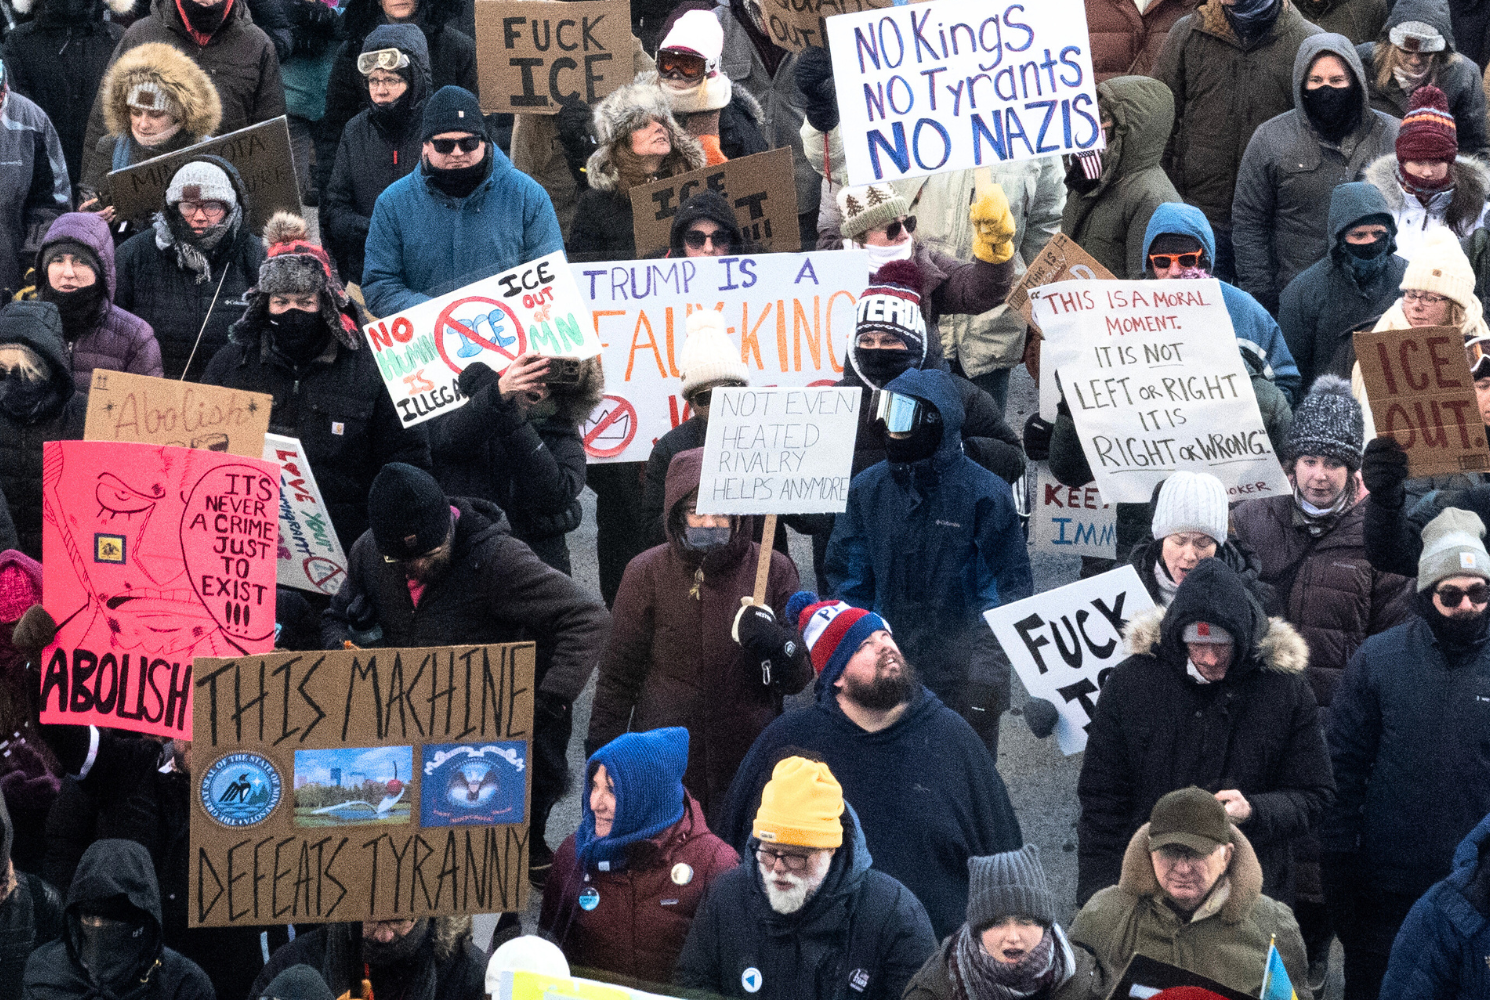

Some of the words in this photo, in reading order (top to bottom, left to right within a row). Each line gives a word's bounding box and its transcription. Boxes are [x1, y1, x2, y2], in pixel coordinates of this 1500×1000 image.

[503, 13, 606, 52] FUCK
[854, 16, 904, 74] NO
[911, 3, 1035, 71] Kings
[510, 53, 613, 107] ICE
[863, 75, 914, 122] NO
[920, 45, 1083, 117] Tyrants
[866, 117, 952, 180] NO
[970, 93, 1100, 166] NAZIS
[498, 261, 556, 298] ICE
[583, 260, 697, 301] TRUMP
[717, 257, 759, 292] IS
[794, 256, 820, 286] A
[522, 286, 555, 309] OUT
[368, 316, 414, 352] NO
[446, 308, 517, 359] ICE
[529, 312, 585, 355] MN
[1105, 315, 1182, 336] MOMENT.
[1095, 345, 1112, 368] IT
[1118, 345, 1138, 366] IS
[1144, 342, 1184, 365] NOT
[1376, 336, 1463, 395] ICE
[403, 369, 435, 396] IS
[1074, 376, 1135, 410] LEFT
[1139, 384, 1164, 400] OR
[1162, 373, 1241, 402] RIGHT
[115, 387, 250, 439] Abolish
[721, 391, 778, 418] NOT
[785, 389, 859, 416] EVEN
[1138, 409, 1160, 432] IT
[1167, 408, 1187, 428] IS
[721, 424, 820, 450] HEATED
[1386, 400, 1485, 450] OUT.
[718, 450, 806, 474] RIVALRY
[224, 473, 273, 501] IT'S
[712, 477, 773, 501] HELPS
[779, 477, 850, 502] ANYMORE
[205, 495, 268, 519] NEVER
[190, 513, 208, 531] A
[214, 513, 276, 542] CRIME
[212, 536, 271, 560] JUST
[220, 556, 250, 579] TO
[201, 575, 268, 605] EXIST
[1012, 590, 1130, 676] FUCK
[40, 648, 191, 731] ABOLISH
[196, 656, 328, 747] THIS
[343, 645, 535, 741] MACHINE
[249, 755, 274, 776] STATE
[199, 832, 349, 923] DEFEATS
[362, 826, 530, 915] TYRANNY
